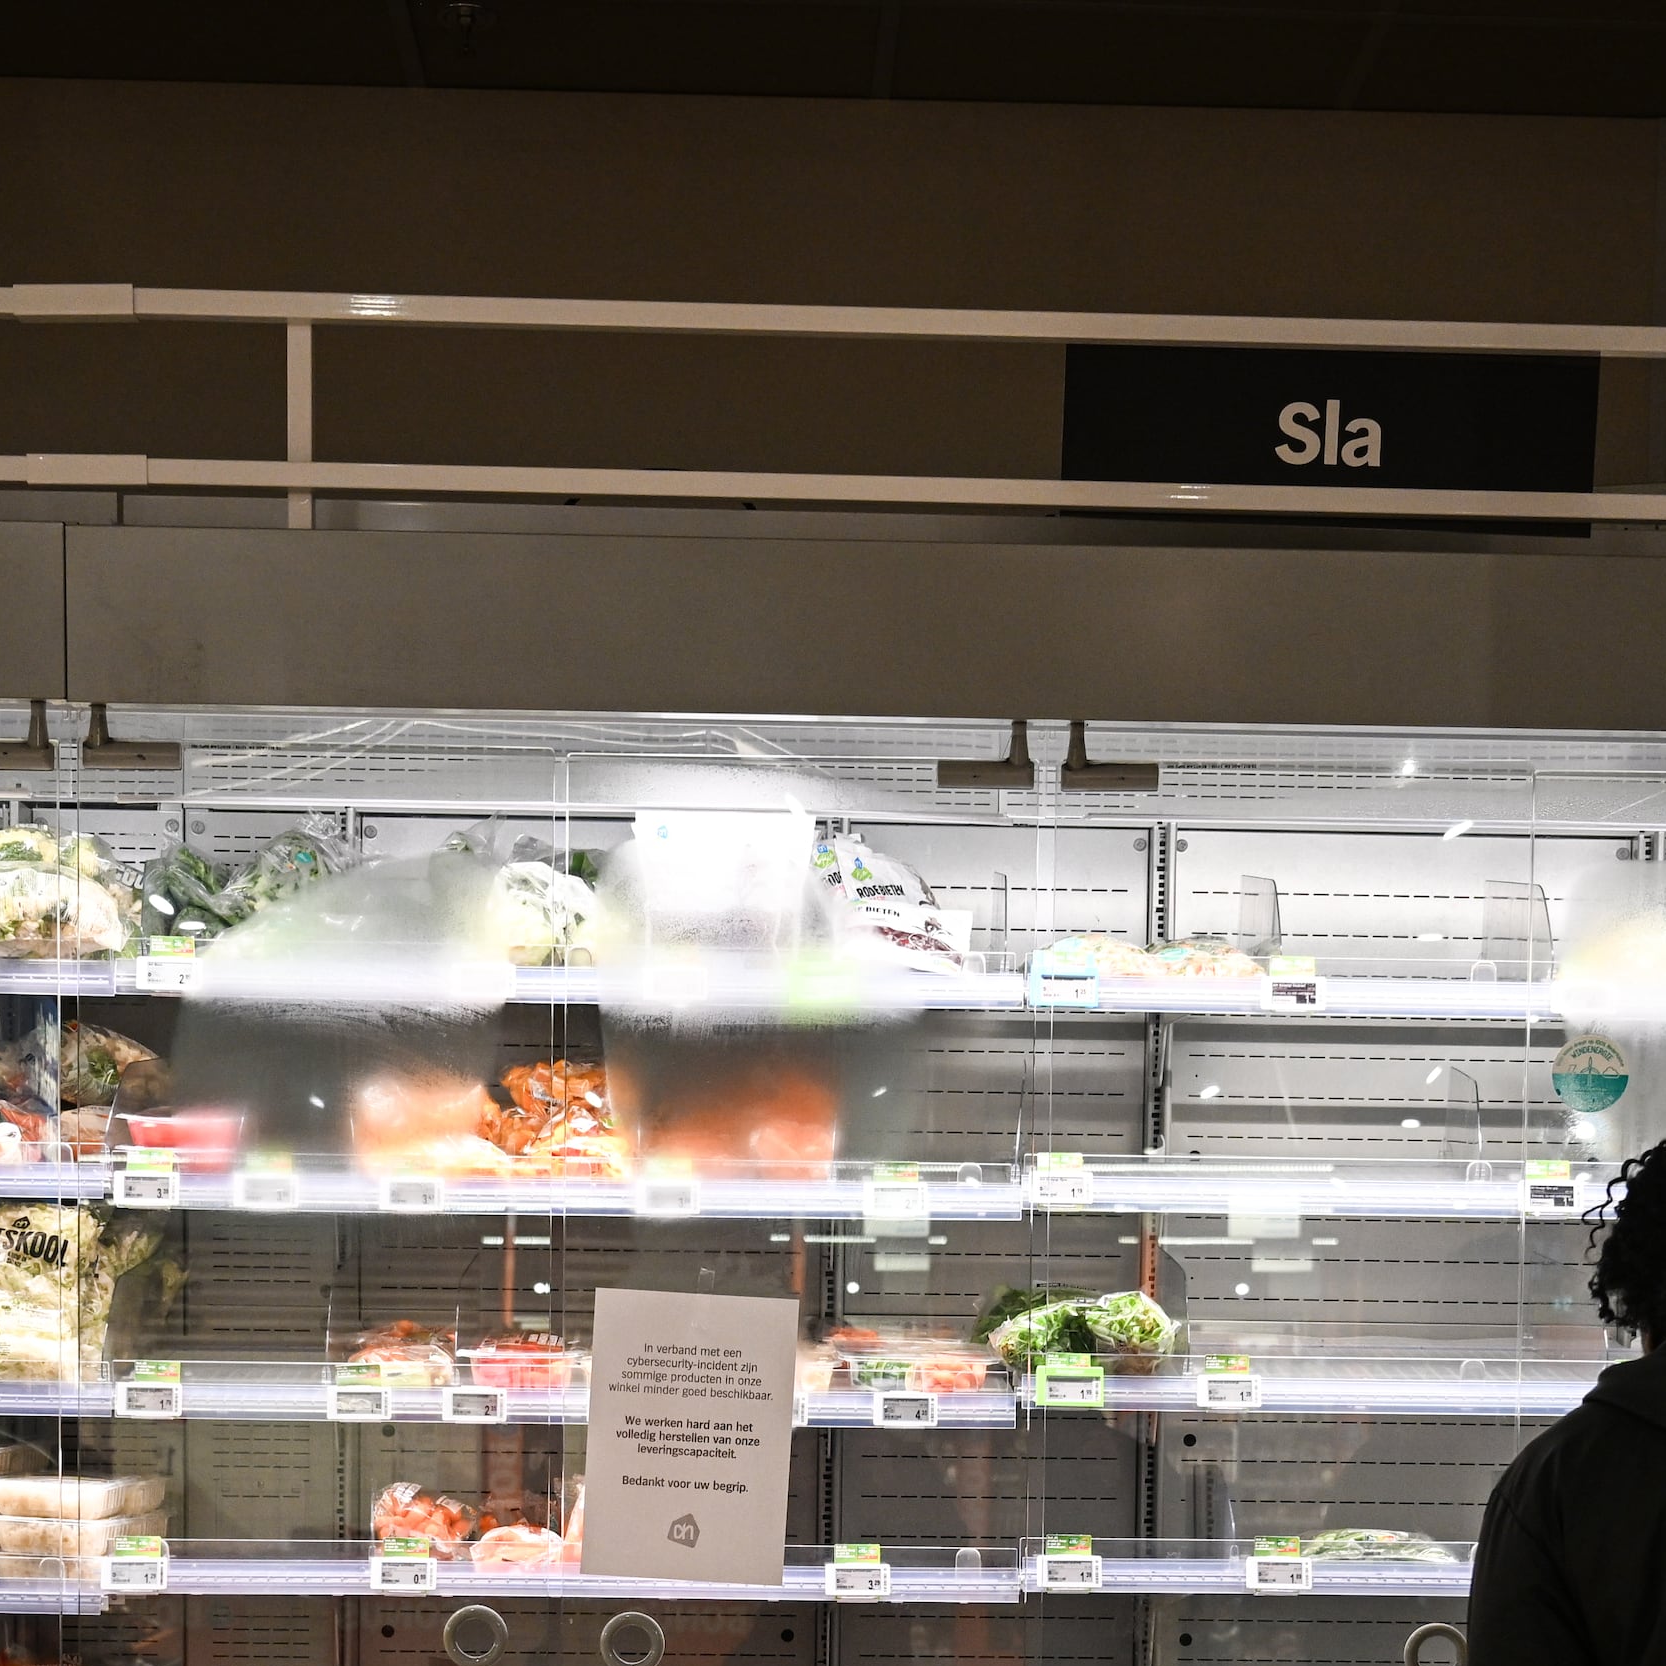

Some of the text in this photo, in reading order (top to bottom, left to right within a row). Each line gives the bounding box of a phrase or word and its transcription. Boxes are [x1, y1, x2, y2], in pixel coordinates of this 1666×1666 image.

[1275, 399, 1381, 466] Sla
[1572, 1046, 1613, 1061] WINDENERGIE
[645, 1344, 742, 1358] In verband met een
[627, 1357, 758, 1373] cybersecurity-incident zijn
[622, 1370, 762, 1387] sommige producten in onze
[609, 1382, 773, 1401] winkel minder goed beschikbaar.
[625, 1416, 753, 1432] We werken hard aan het
[616, 1429, 760, 1447] volledig herstellen van onze
[638, 1444, 737, 1459] leveringscapaciteit.
[622, 1476, 749, 1494] Bedankt voor uw begrip.
